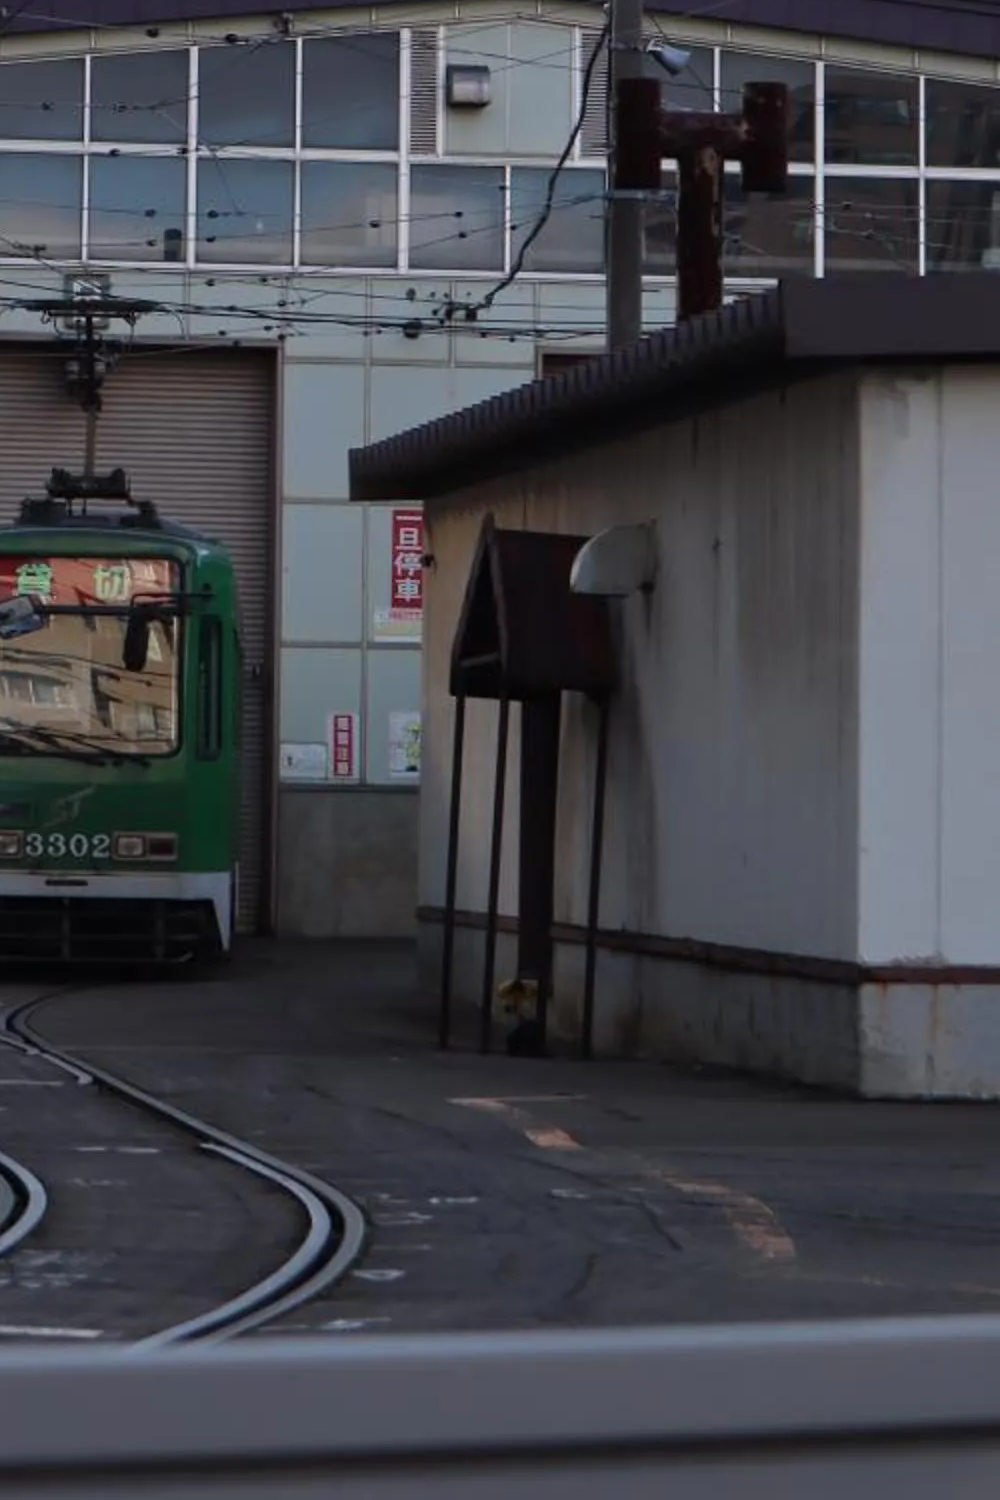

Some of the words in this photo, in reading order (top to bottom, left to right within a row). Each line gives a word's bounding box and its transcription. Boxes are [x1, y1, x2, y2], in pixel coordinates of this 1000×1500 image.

[394, 515, 423, 602] 一旦停車
[25, 833, 111, 858] 3302
